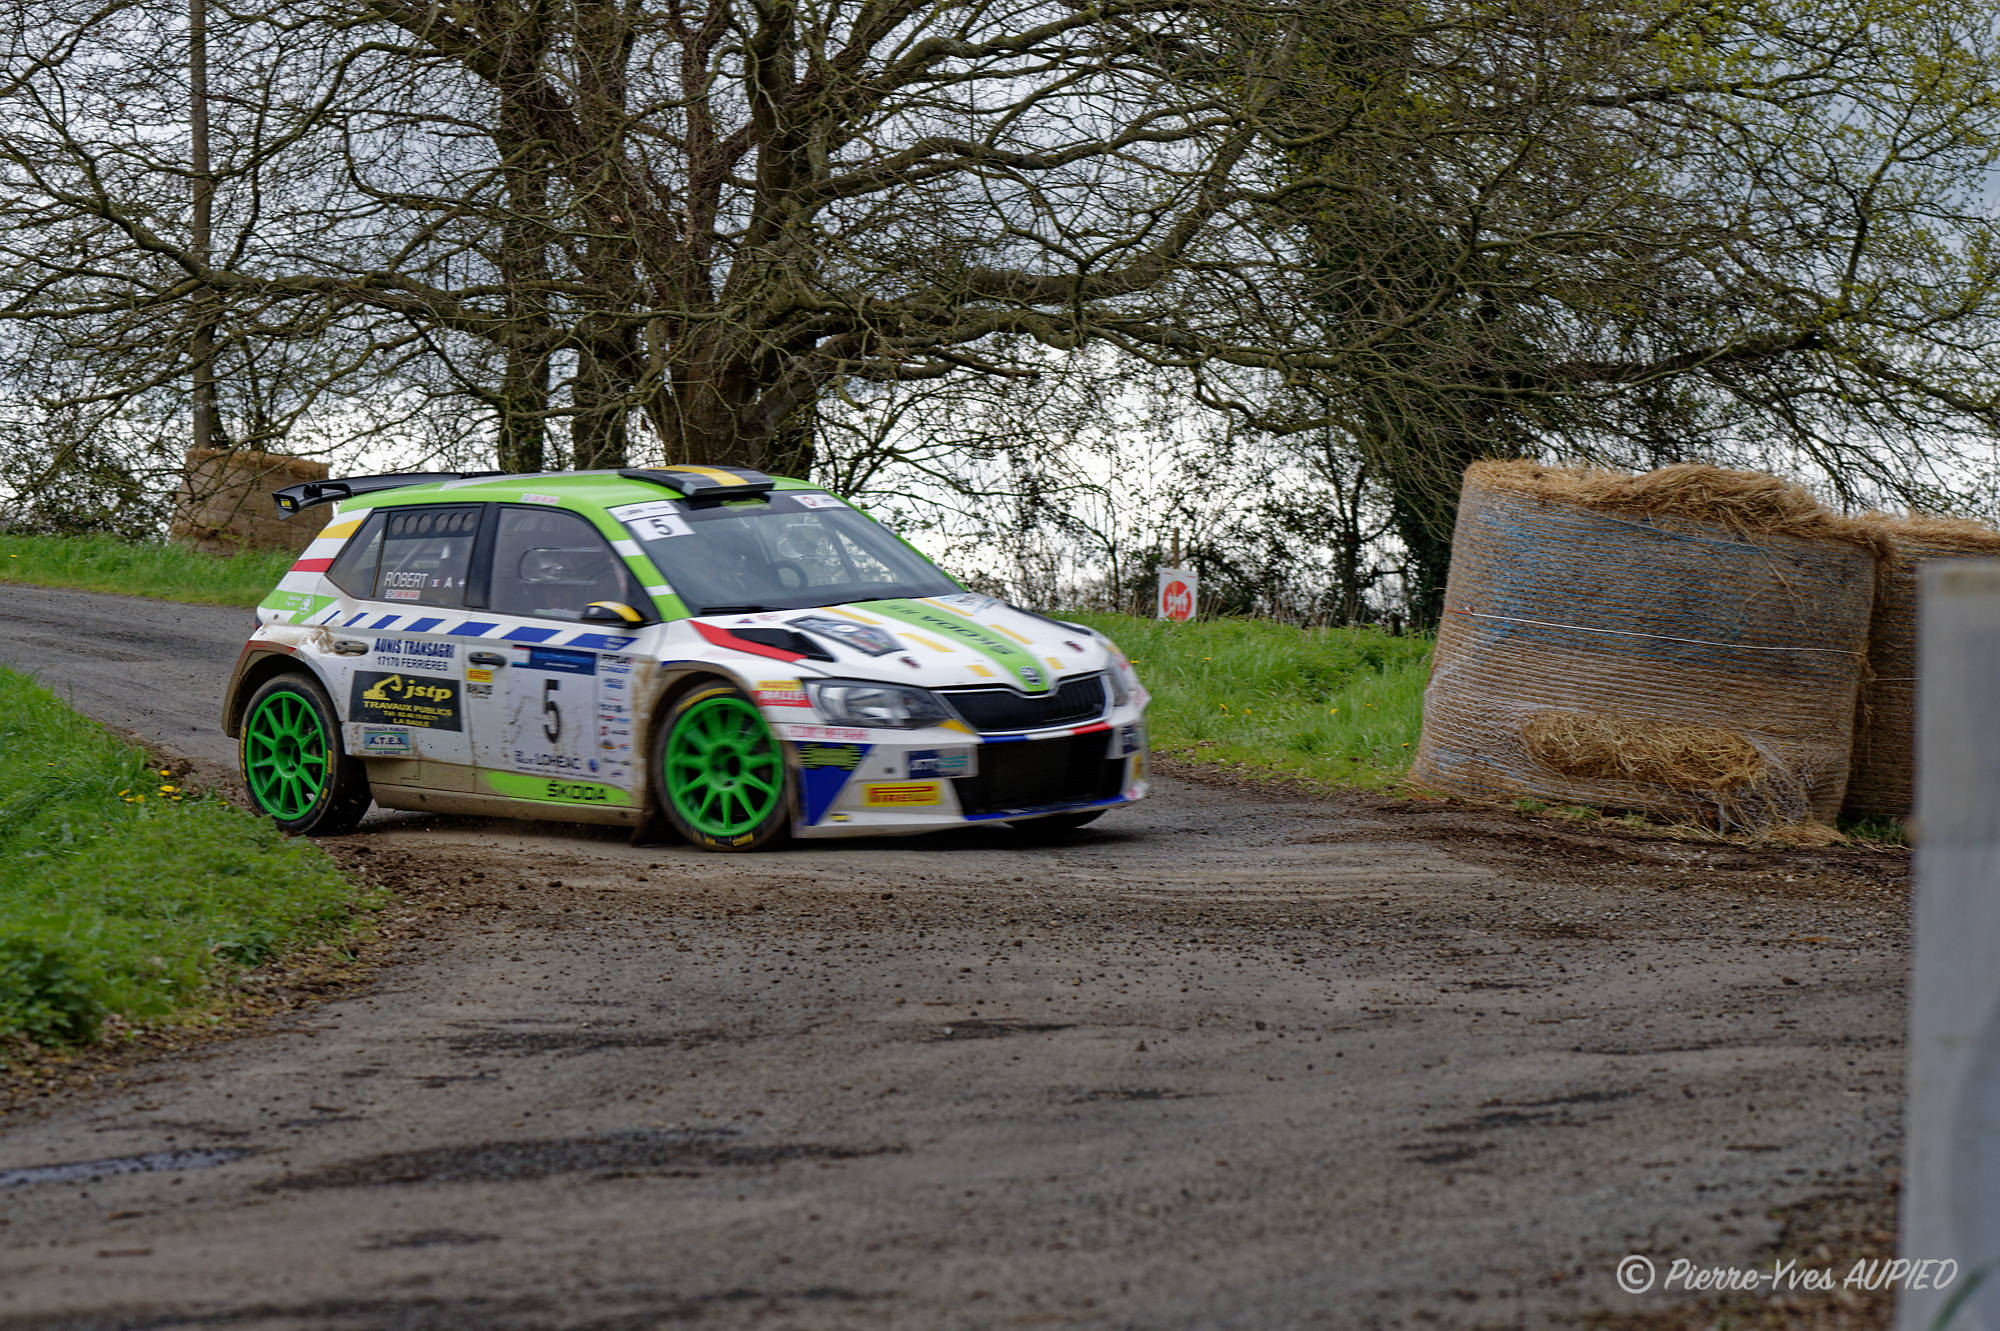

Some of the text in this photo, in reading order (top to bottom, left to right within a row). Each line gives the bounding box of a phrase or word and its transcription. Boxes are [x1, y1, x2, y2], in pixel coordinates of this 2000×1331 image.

[649, 519, 673, 536] 5
[384, 572, 429, 589] ROBERT
[374, 638, 456, 658] AUNIS TRANSAGRI
[376, 656, 399, 667] 17170
[403, 679, 454, 702] jstp
[363, 701, 453, 716] TRAVAUX PUBLICS
[544, 678, 561, 744] 5
